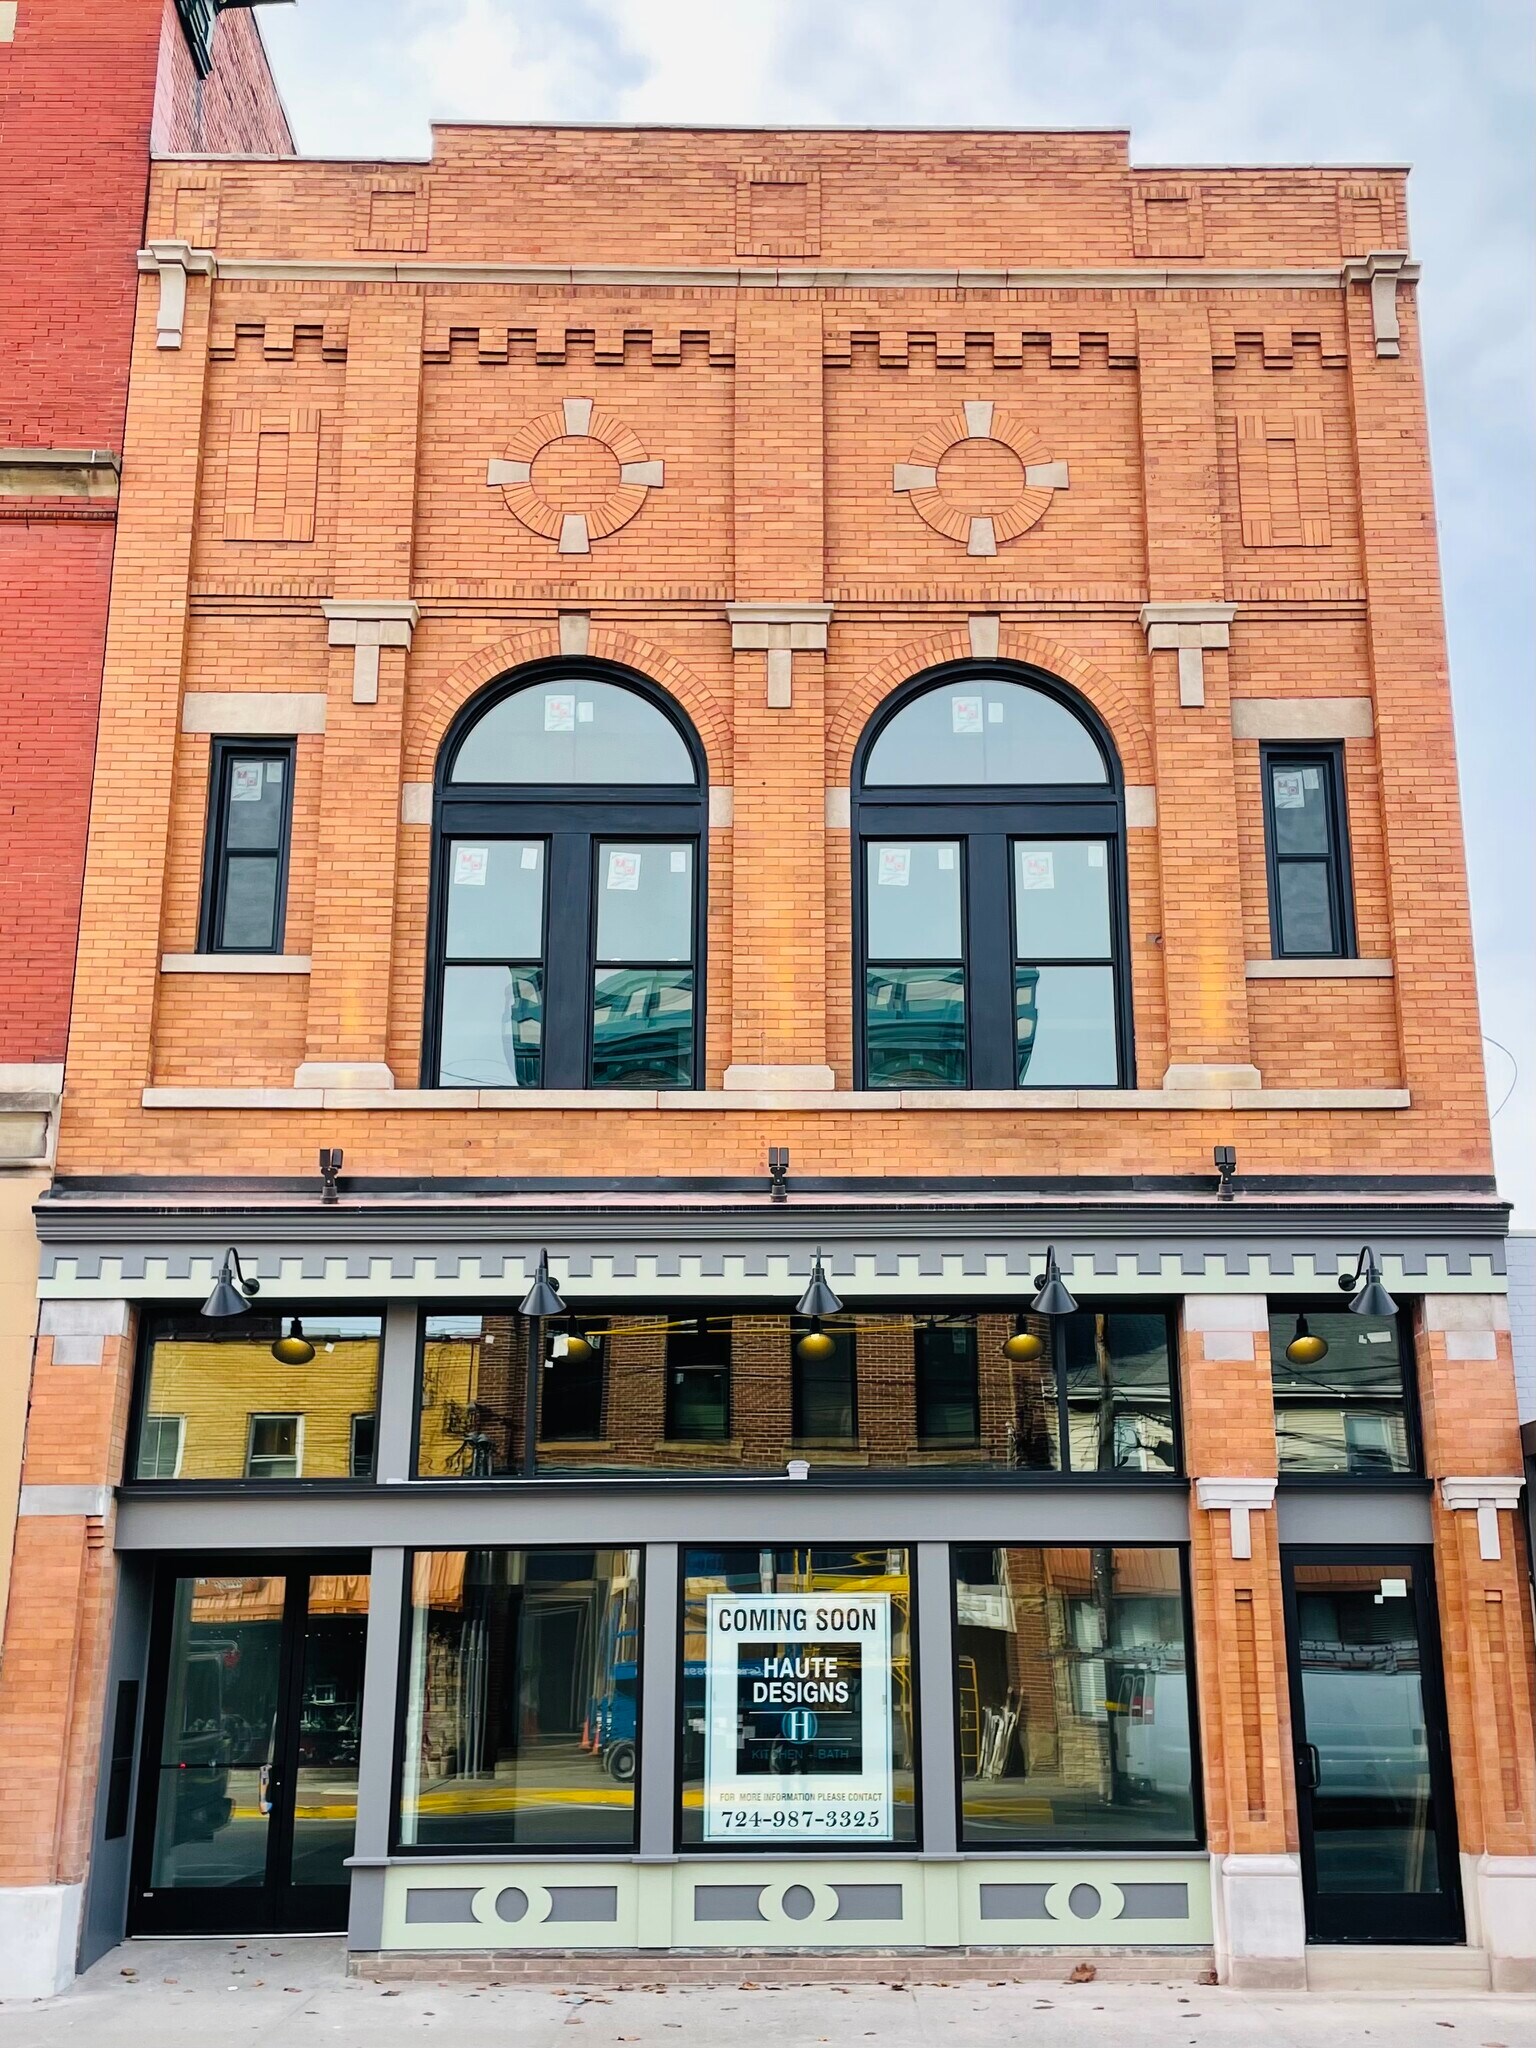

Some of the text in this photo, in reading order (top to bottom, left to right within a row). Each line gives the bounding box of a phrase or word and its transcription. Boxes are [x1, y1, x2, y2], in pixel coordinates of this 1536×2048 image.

[719, 1608, 876, 1631] COMING SOON
[763, 1657, 838, 1678] HAUTE
[753, 1682, 849, 1703] DESIGNS
[818, 1749, 849, 1760] BATH
[720, 1793, 882, 1801] FOR MORE INFORMATION PLEASE CONTACT
[721, 1811, 880, 1828] 724-987-3325
